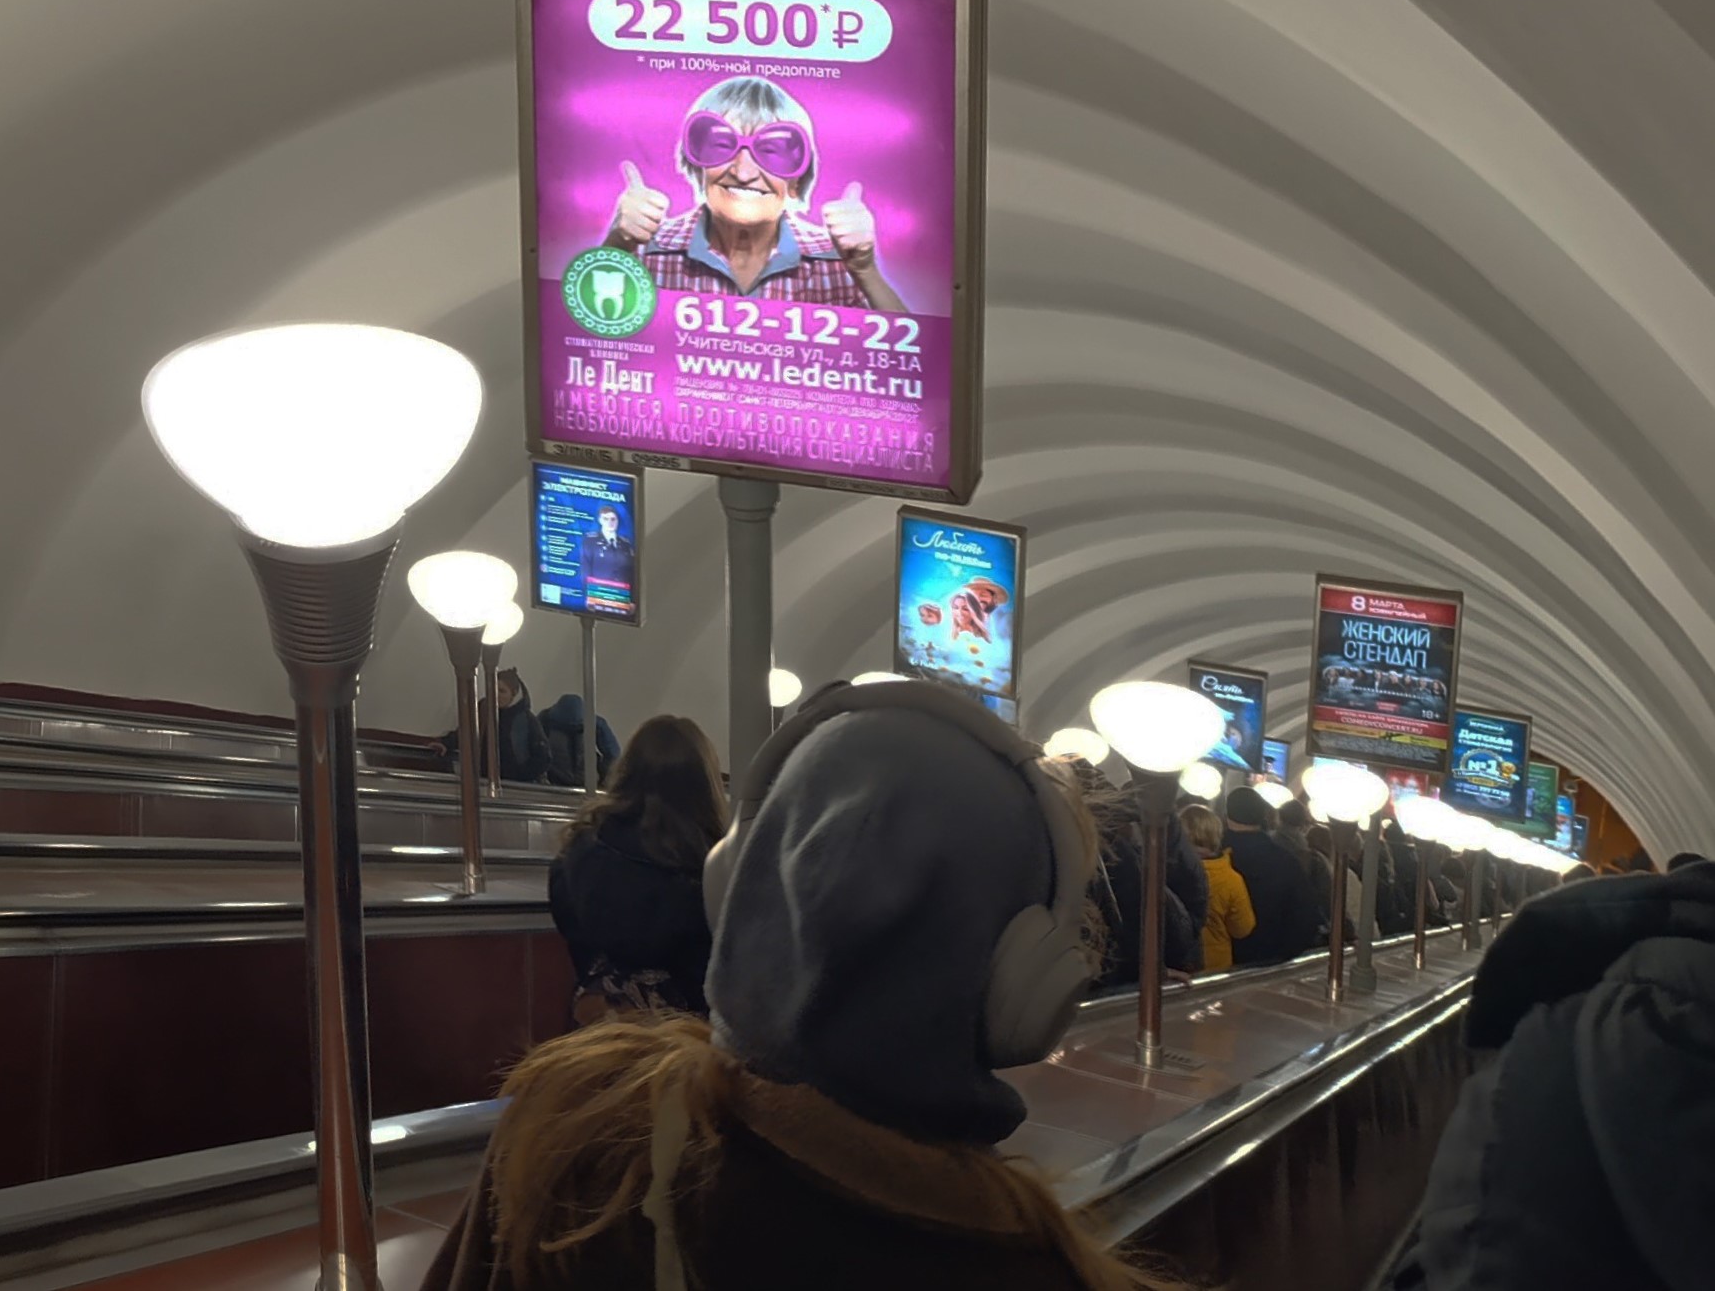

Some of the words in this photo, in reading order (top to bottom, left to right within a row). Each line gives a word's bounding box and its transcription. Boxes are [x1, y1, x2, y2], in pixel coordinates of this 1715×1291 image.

[649, 58, 676, 72] при
[680, 56, 752, 74] 100%-ной
[755, 63, 842, 79] предоплате
[674, 295, 922, 354] 612-12-22
[674, 330, 796, 359] Учительская
[566, 355, 596, 388] Ле
[600, 359, 656, 396] Дент
[674, 352, 923, 400] www.ledent.ru
[554, 389, 662, 419] ИМЕЮТСЯ
[677, 402, 934, 453] ПРОТИВОПОКАЗАНИЯ
[554, 409, 666, 440] НЕОБХОДИМА
[669, 422, 803, 459] КОНСУЛЬТАЦИЯ
[807, 439, 935, 473] СПЕЦИАЛИСТА
[1351, 595, 1366, 611] 8
[1341, 619, 1431, 649] ЖЕНСКИЙ
[1343, 640, 1427, 669] СТЕНДАП
[1421, 709, 1440, 720] 18+
